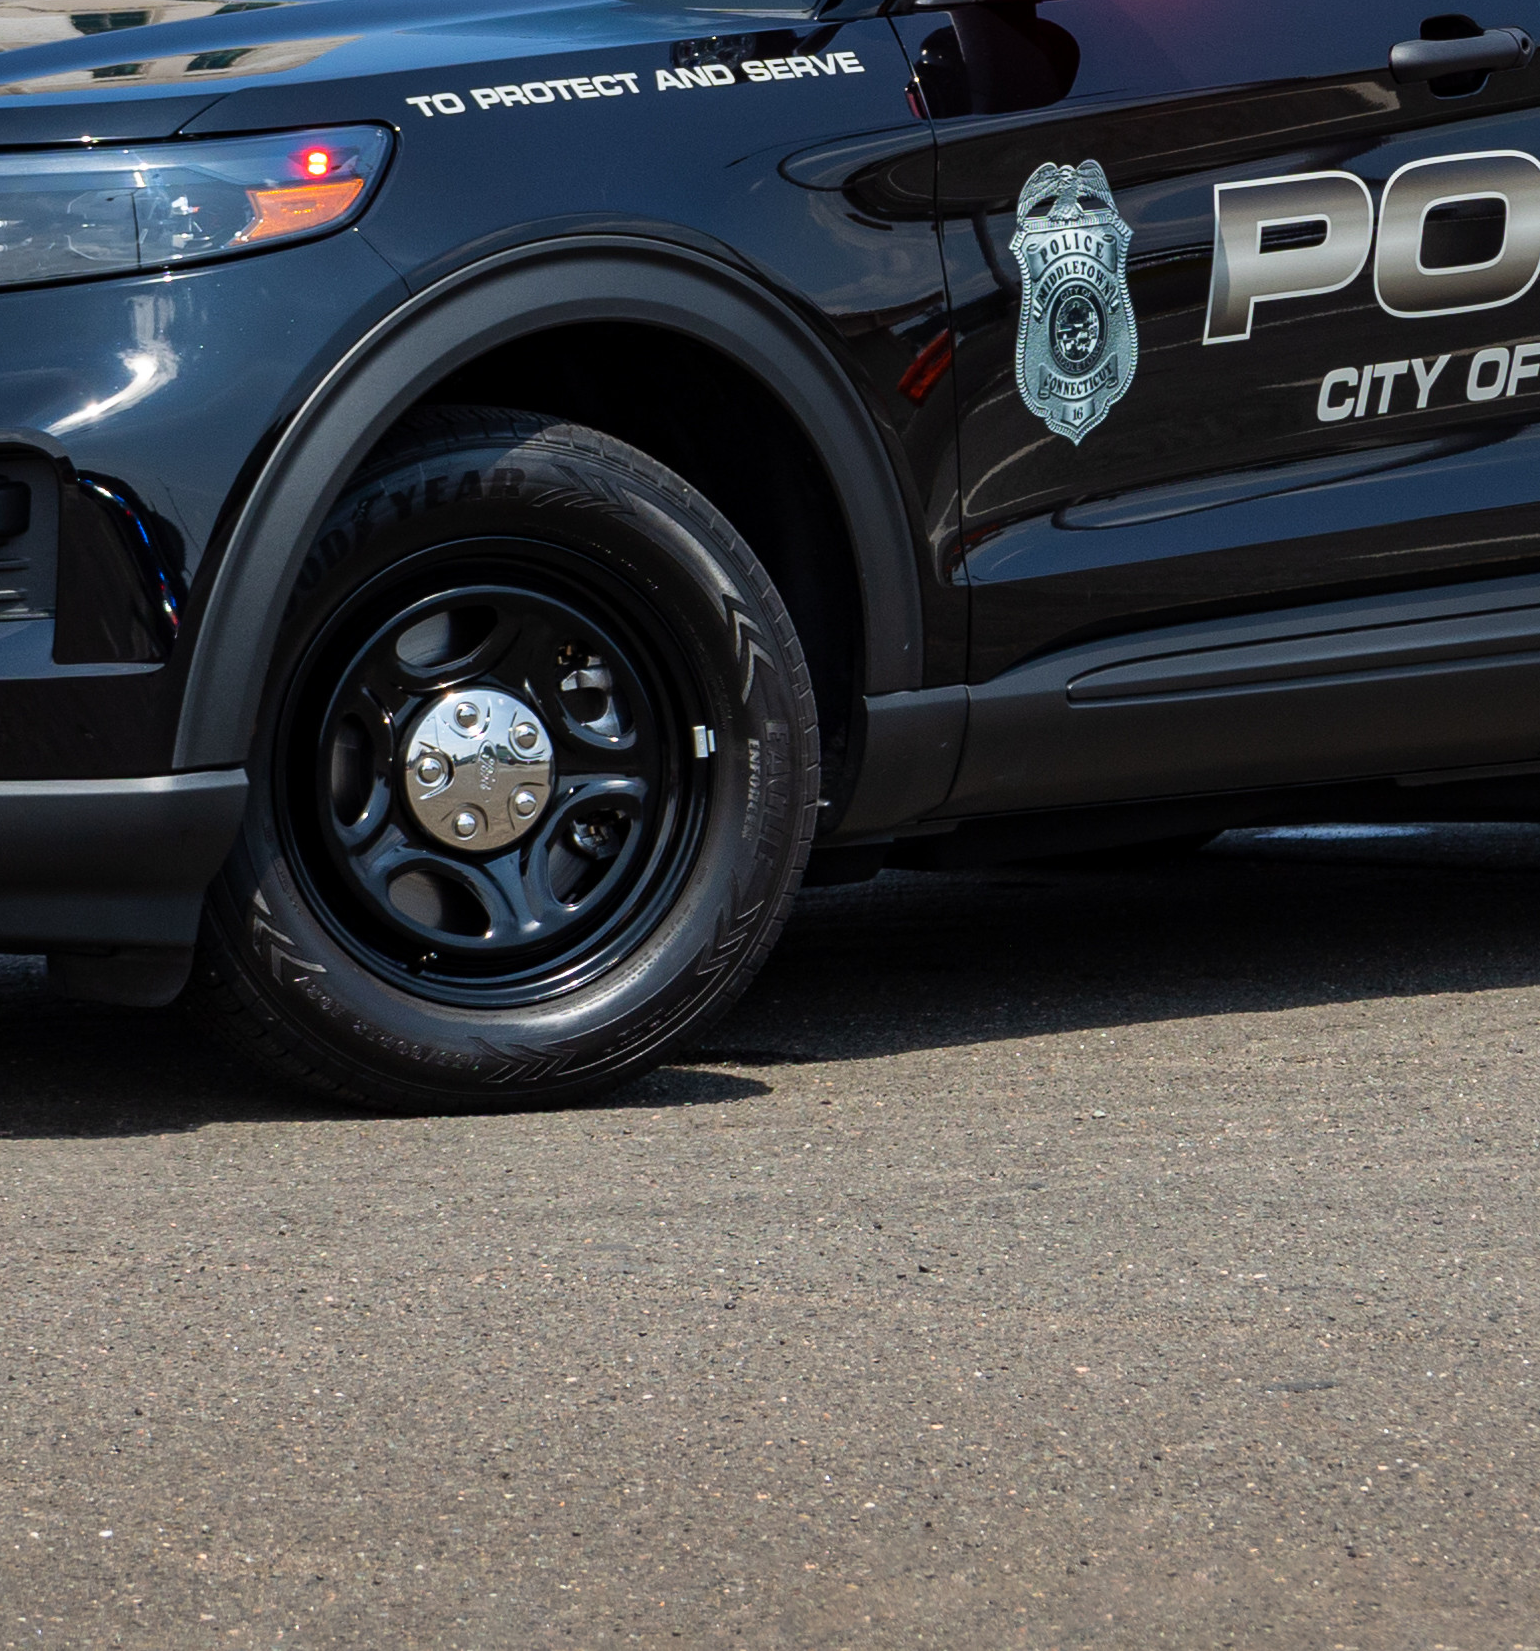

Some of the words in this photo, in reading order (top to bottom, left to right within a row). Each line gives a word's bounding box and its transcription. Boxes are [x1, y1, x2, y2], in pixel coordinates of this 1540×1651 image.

[406, 93, 466, 117] TO
[469, 73, 639, 110] PROTECT
[655, 63, 736, 92] AND
[740, 51, 865, 83] SERVE
[1040, 233, 1104, 263] POLICE
[1036, 260, 1115, 301] MIDDLETOWN
[1044, 363, 1113, 403] CONNECTICUT
[1316, 353, 1451, 422] CITY
[1073, 408, 1083, 421] 16
